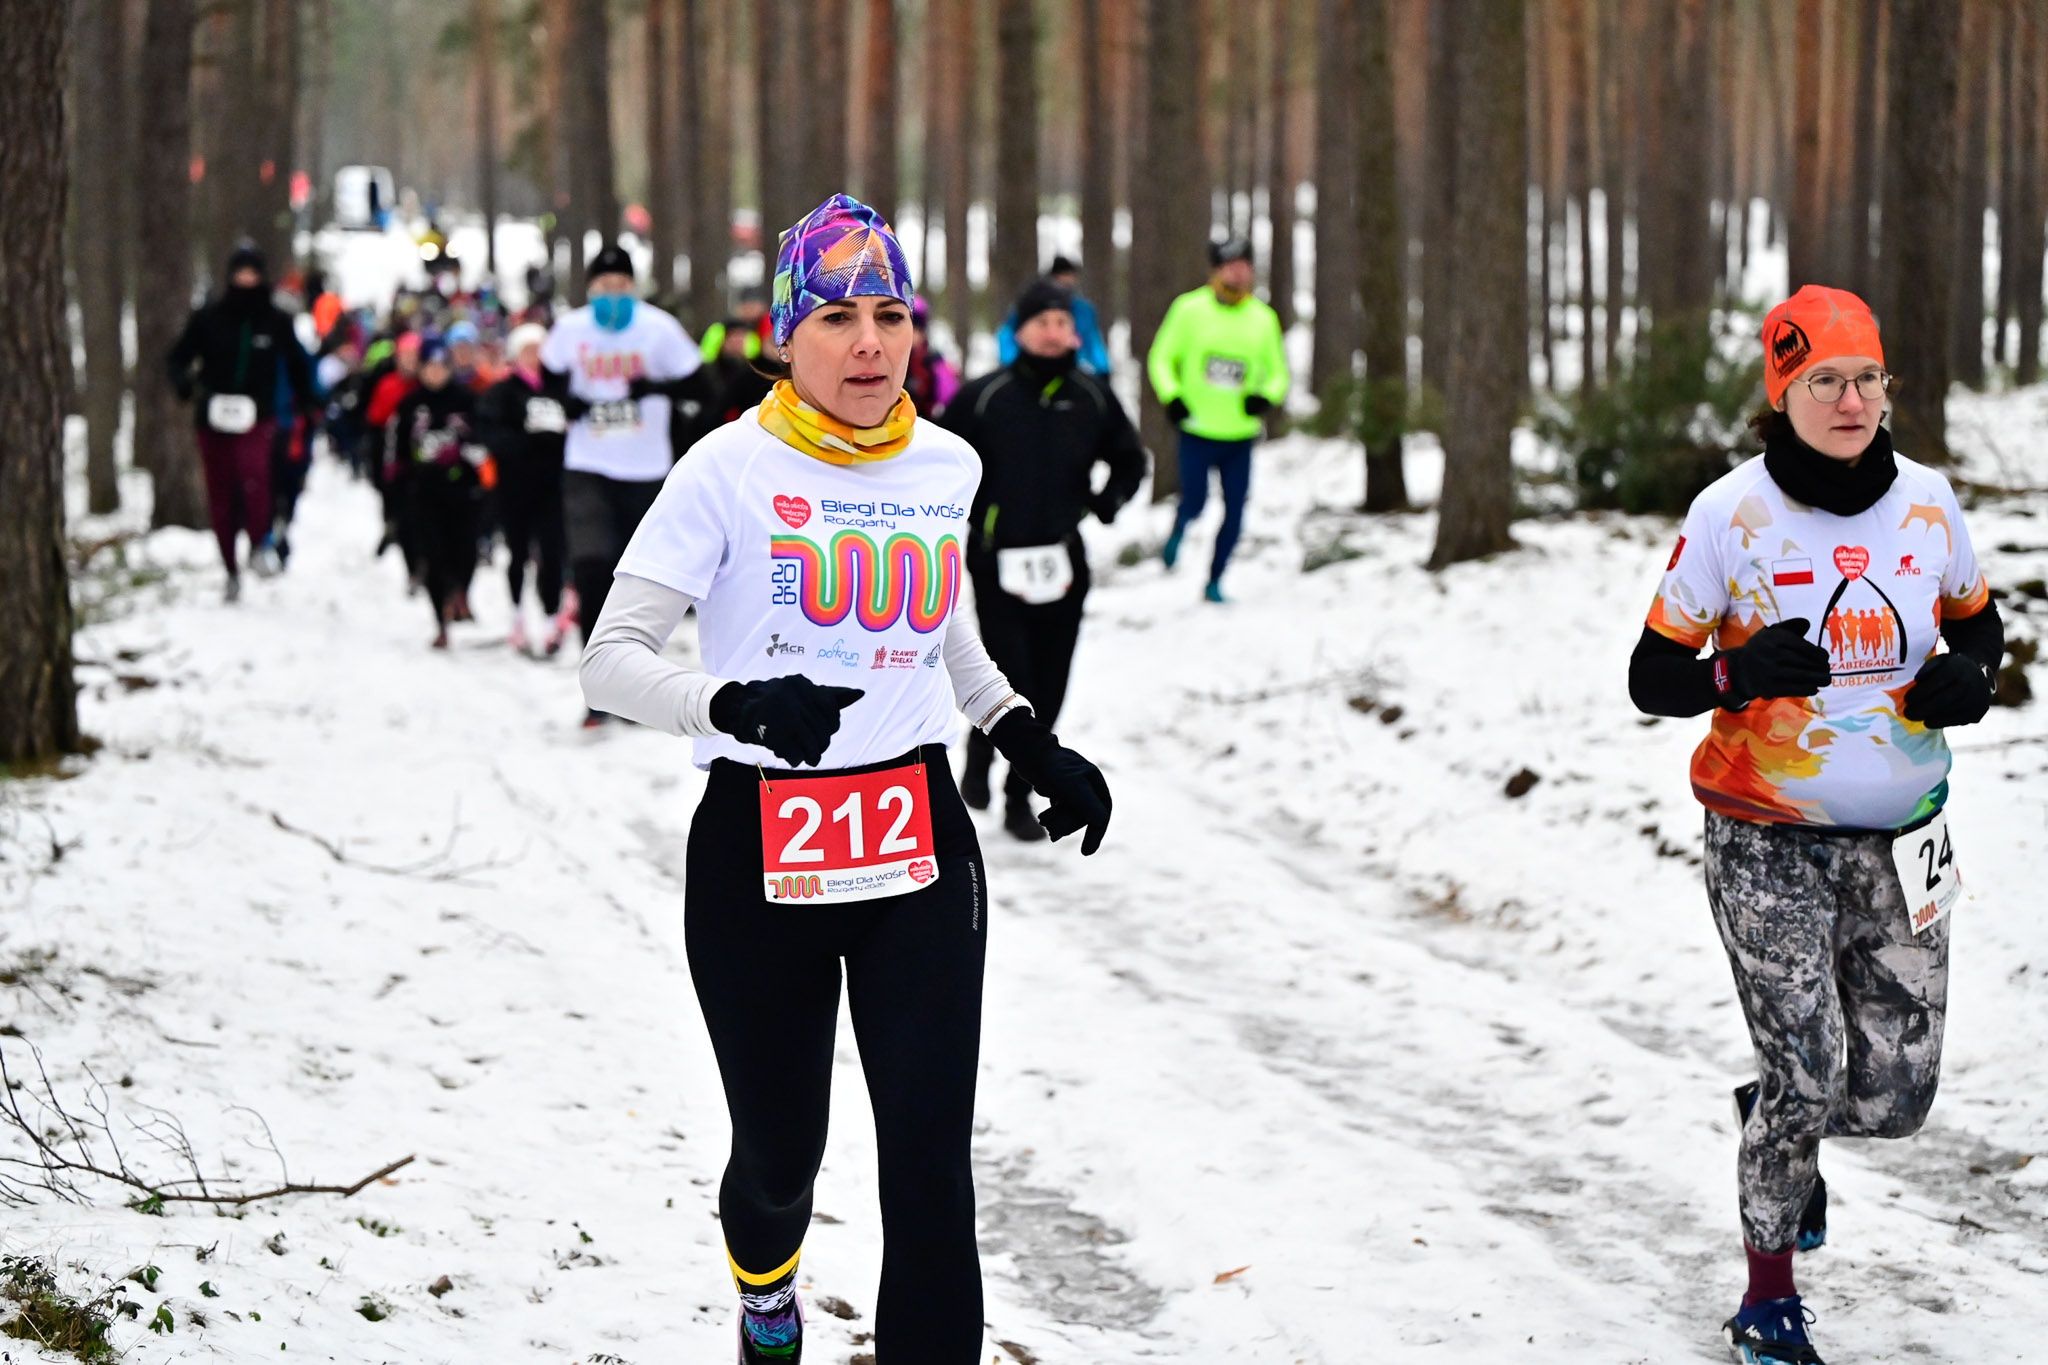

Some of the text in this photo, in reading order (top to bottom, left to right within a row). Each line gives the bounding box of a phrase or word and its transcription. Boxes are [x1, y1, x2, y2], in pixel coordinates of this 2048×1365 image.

[821, 500, 875, 517] Biegi
[881, 502, 915, 517] Dla
[919, 503, 964, 519] WOŚP
[823, 514, 896, 530] Rozgarty
[771, 563, 797, 583] 20
[772, 585, 797, 605] 26
[1829, 658, 1895, 671] ZABIEGANI
[1831, 672, 1893, 687] ŁUBIANKA
[777, 785, 918, 864] 212
[826, 877, 854, 887] Biegi
[856, 876, 874, 885] Dla
[875, 869, 907, 881] WOŚP
[968, 861, 978, 882] GYM
